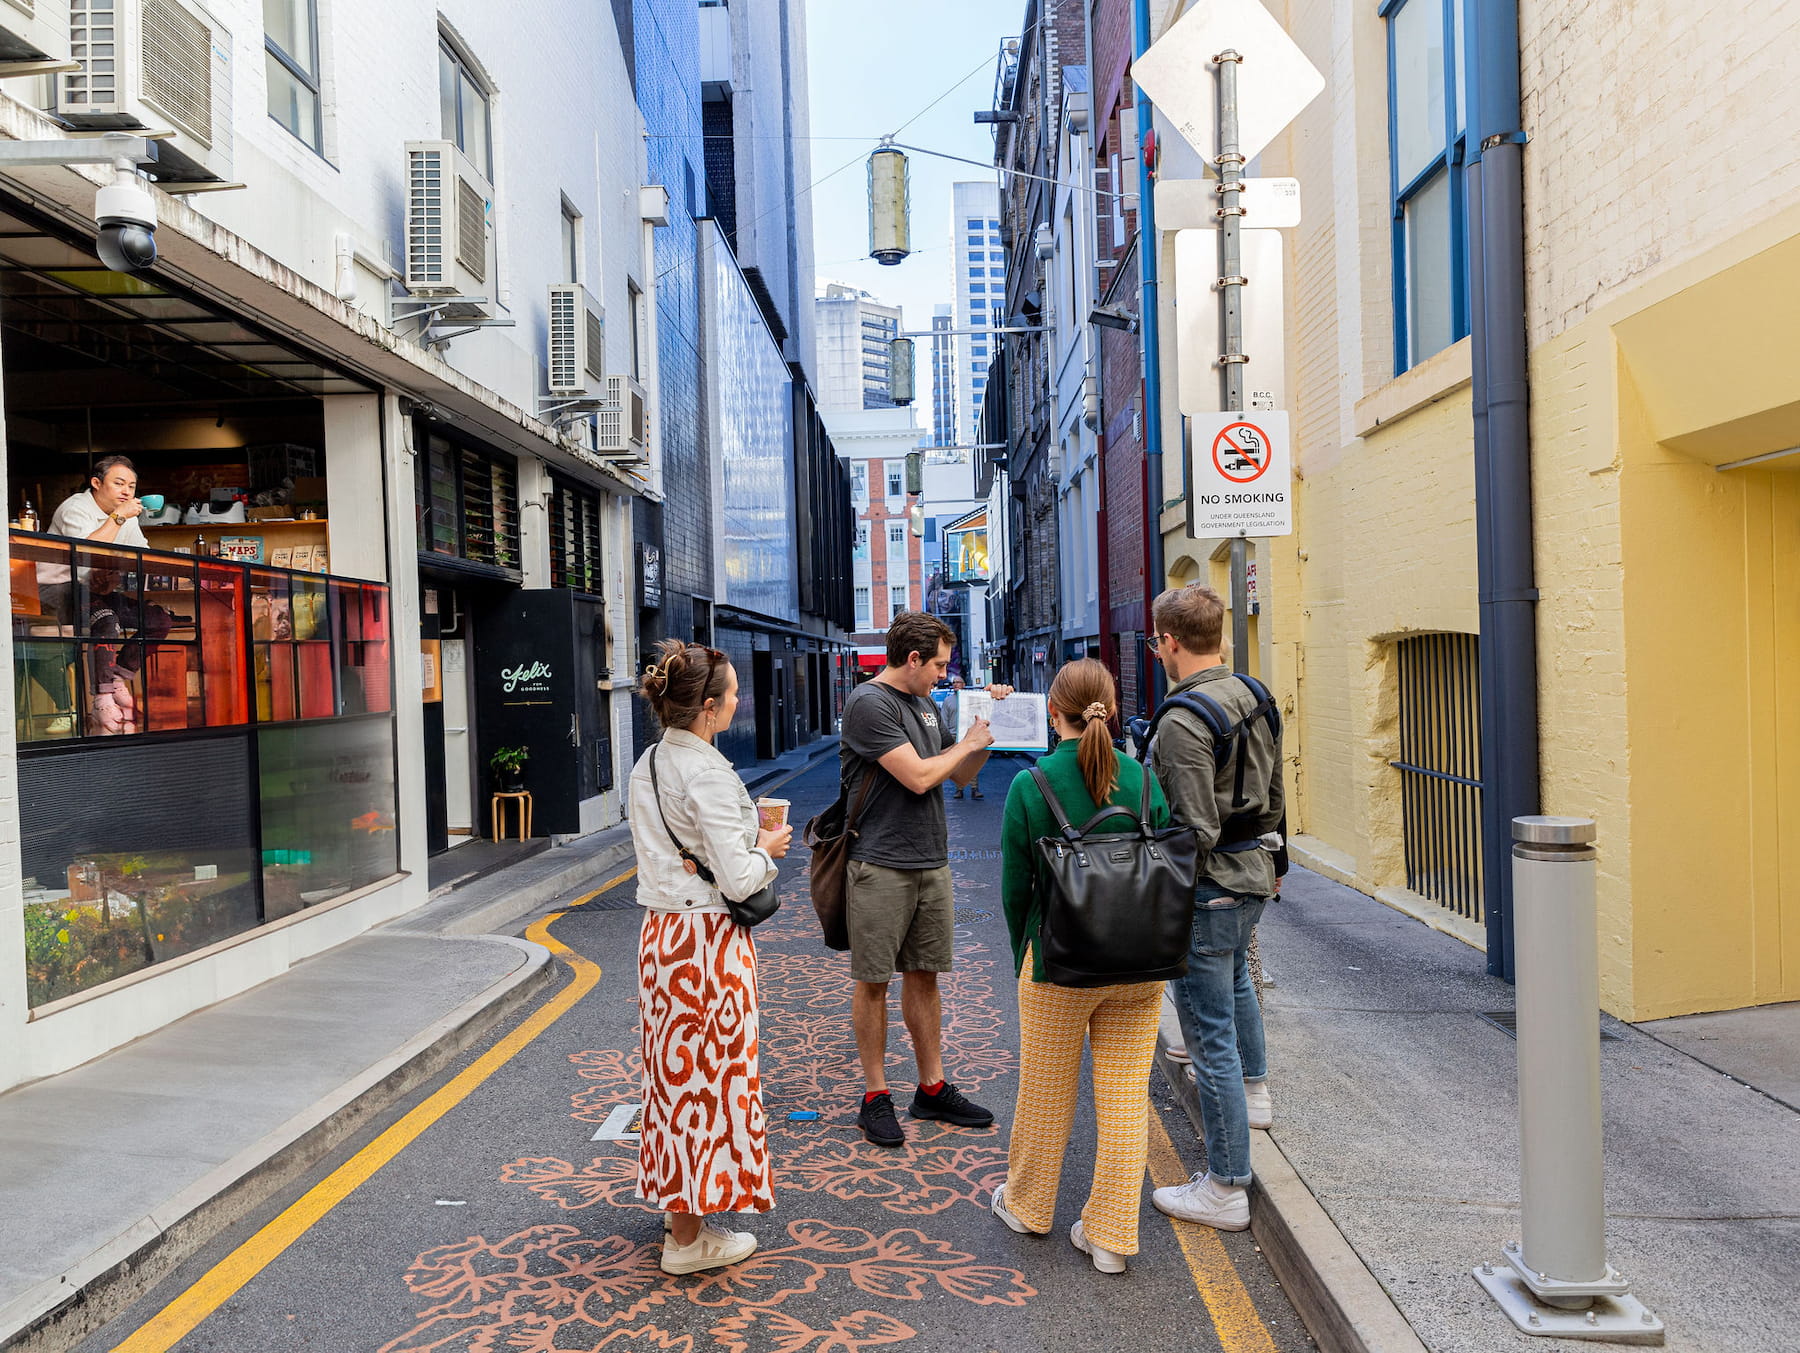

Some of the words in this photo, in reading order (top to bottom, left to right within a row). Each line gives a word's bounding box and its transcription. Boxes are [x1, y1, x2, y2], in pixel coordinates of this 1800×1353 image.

[1201, 494, 1220, 504] NO
[1224, 493, 1284, 504] SMOKING
[1245, 520, 1285, 528] LEGISLATION
[228, 546, 256, 555] MAPS
